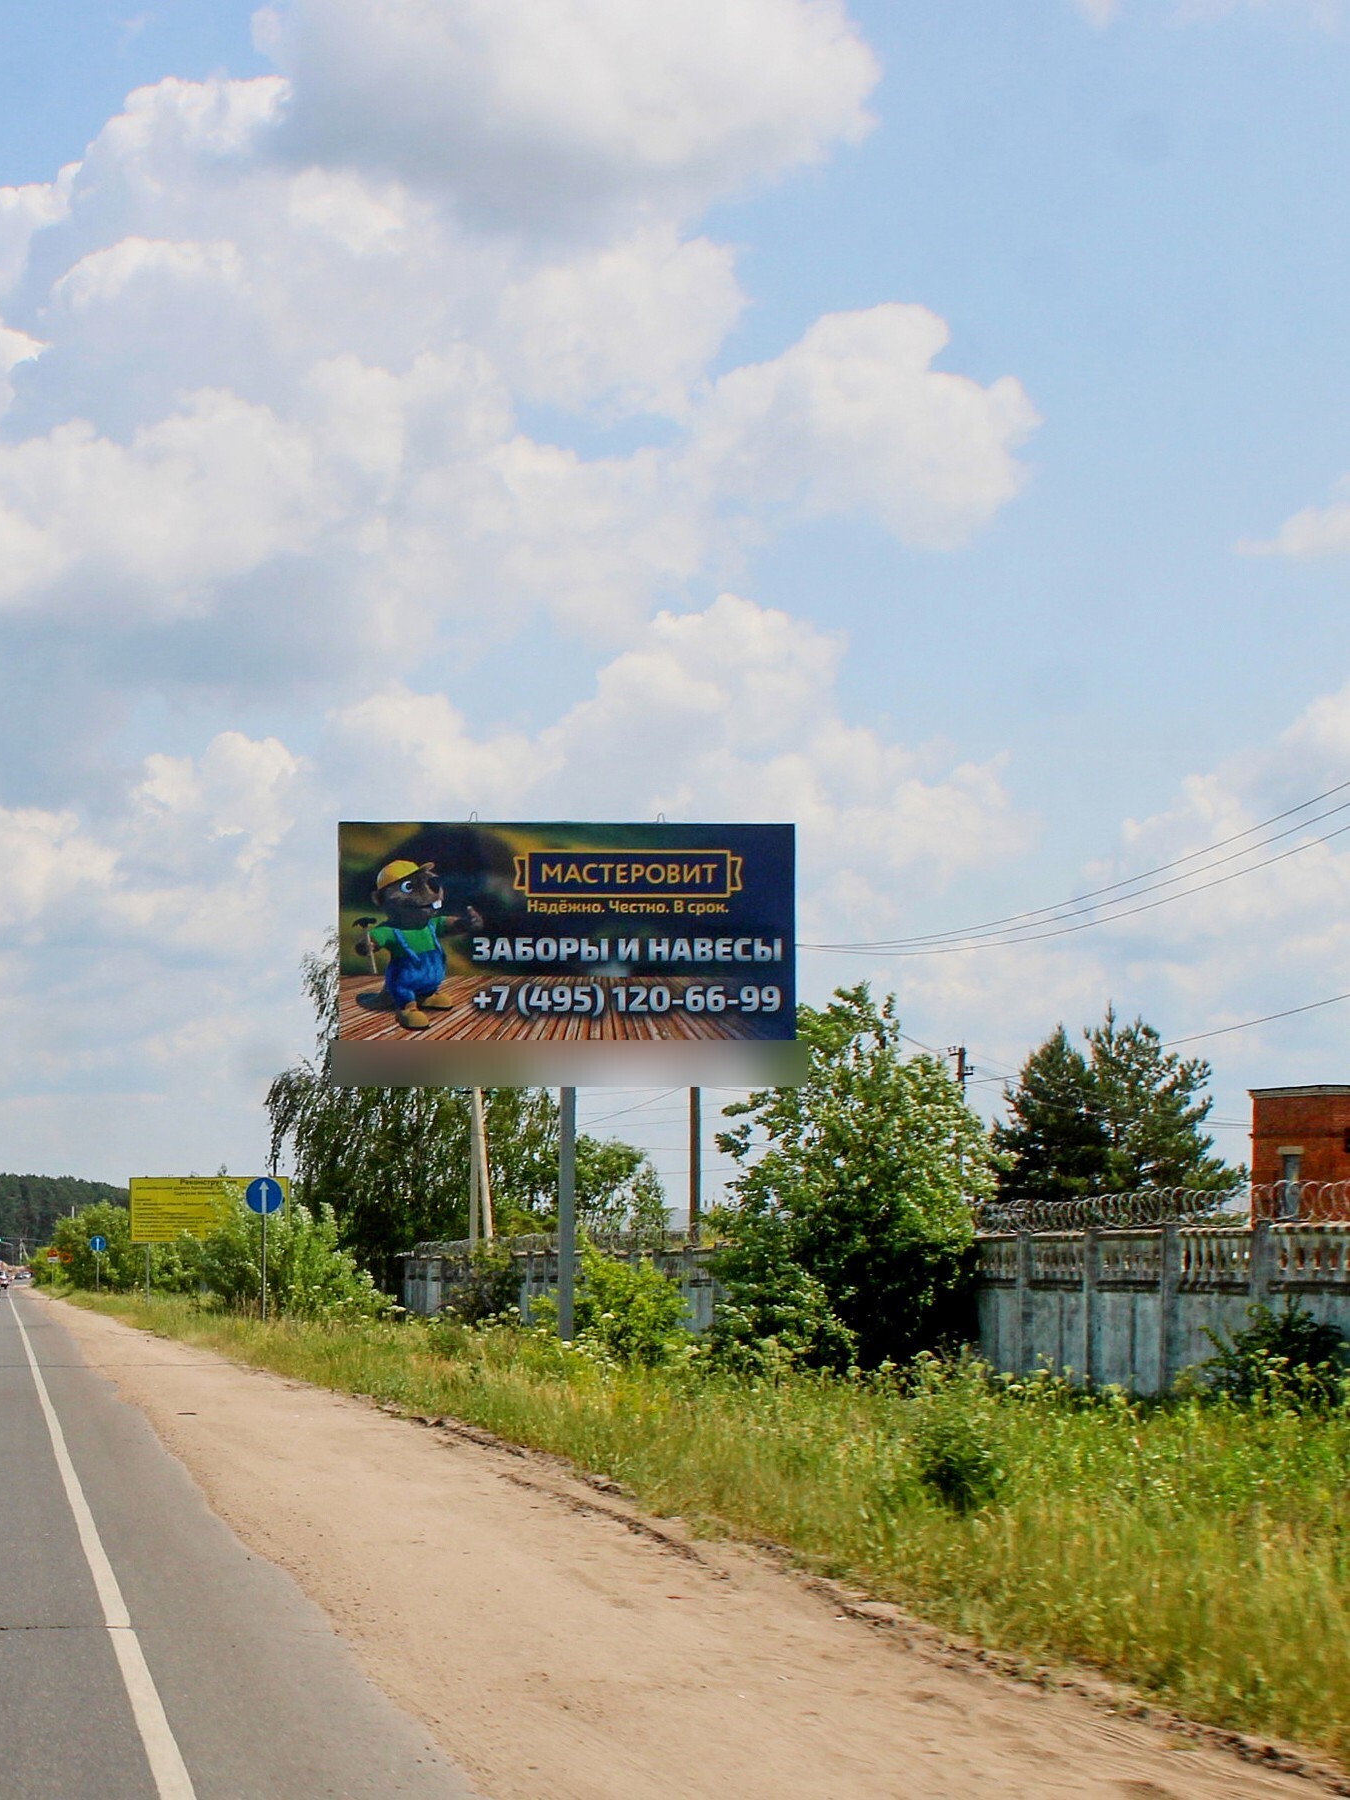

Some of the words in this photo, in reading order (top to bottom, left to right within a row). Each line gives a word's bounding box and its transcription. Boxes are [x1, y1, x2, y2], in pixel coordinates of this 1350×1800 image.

[541, 863, 718, 884] МАСТЕРОВИТ
[527, 899, 605, 915] Надёжно.
[609, 900, 670, 913] Честно.
[673, 901, 685, 913] В
[687, 902, 729, 916] срок.
[472, 937, 609, 962] ЗАБОРЫ
[617, 938, 640, 962] И
[647, 938, 782, 962] НАВЕСЫ
[473, 986, 510, 1012] +7
[517, 983, 605, 1016] (495)
[612, 985, 781, 1013] 120-66-99
